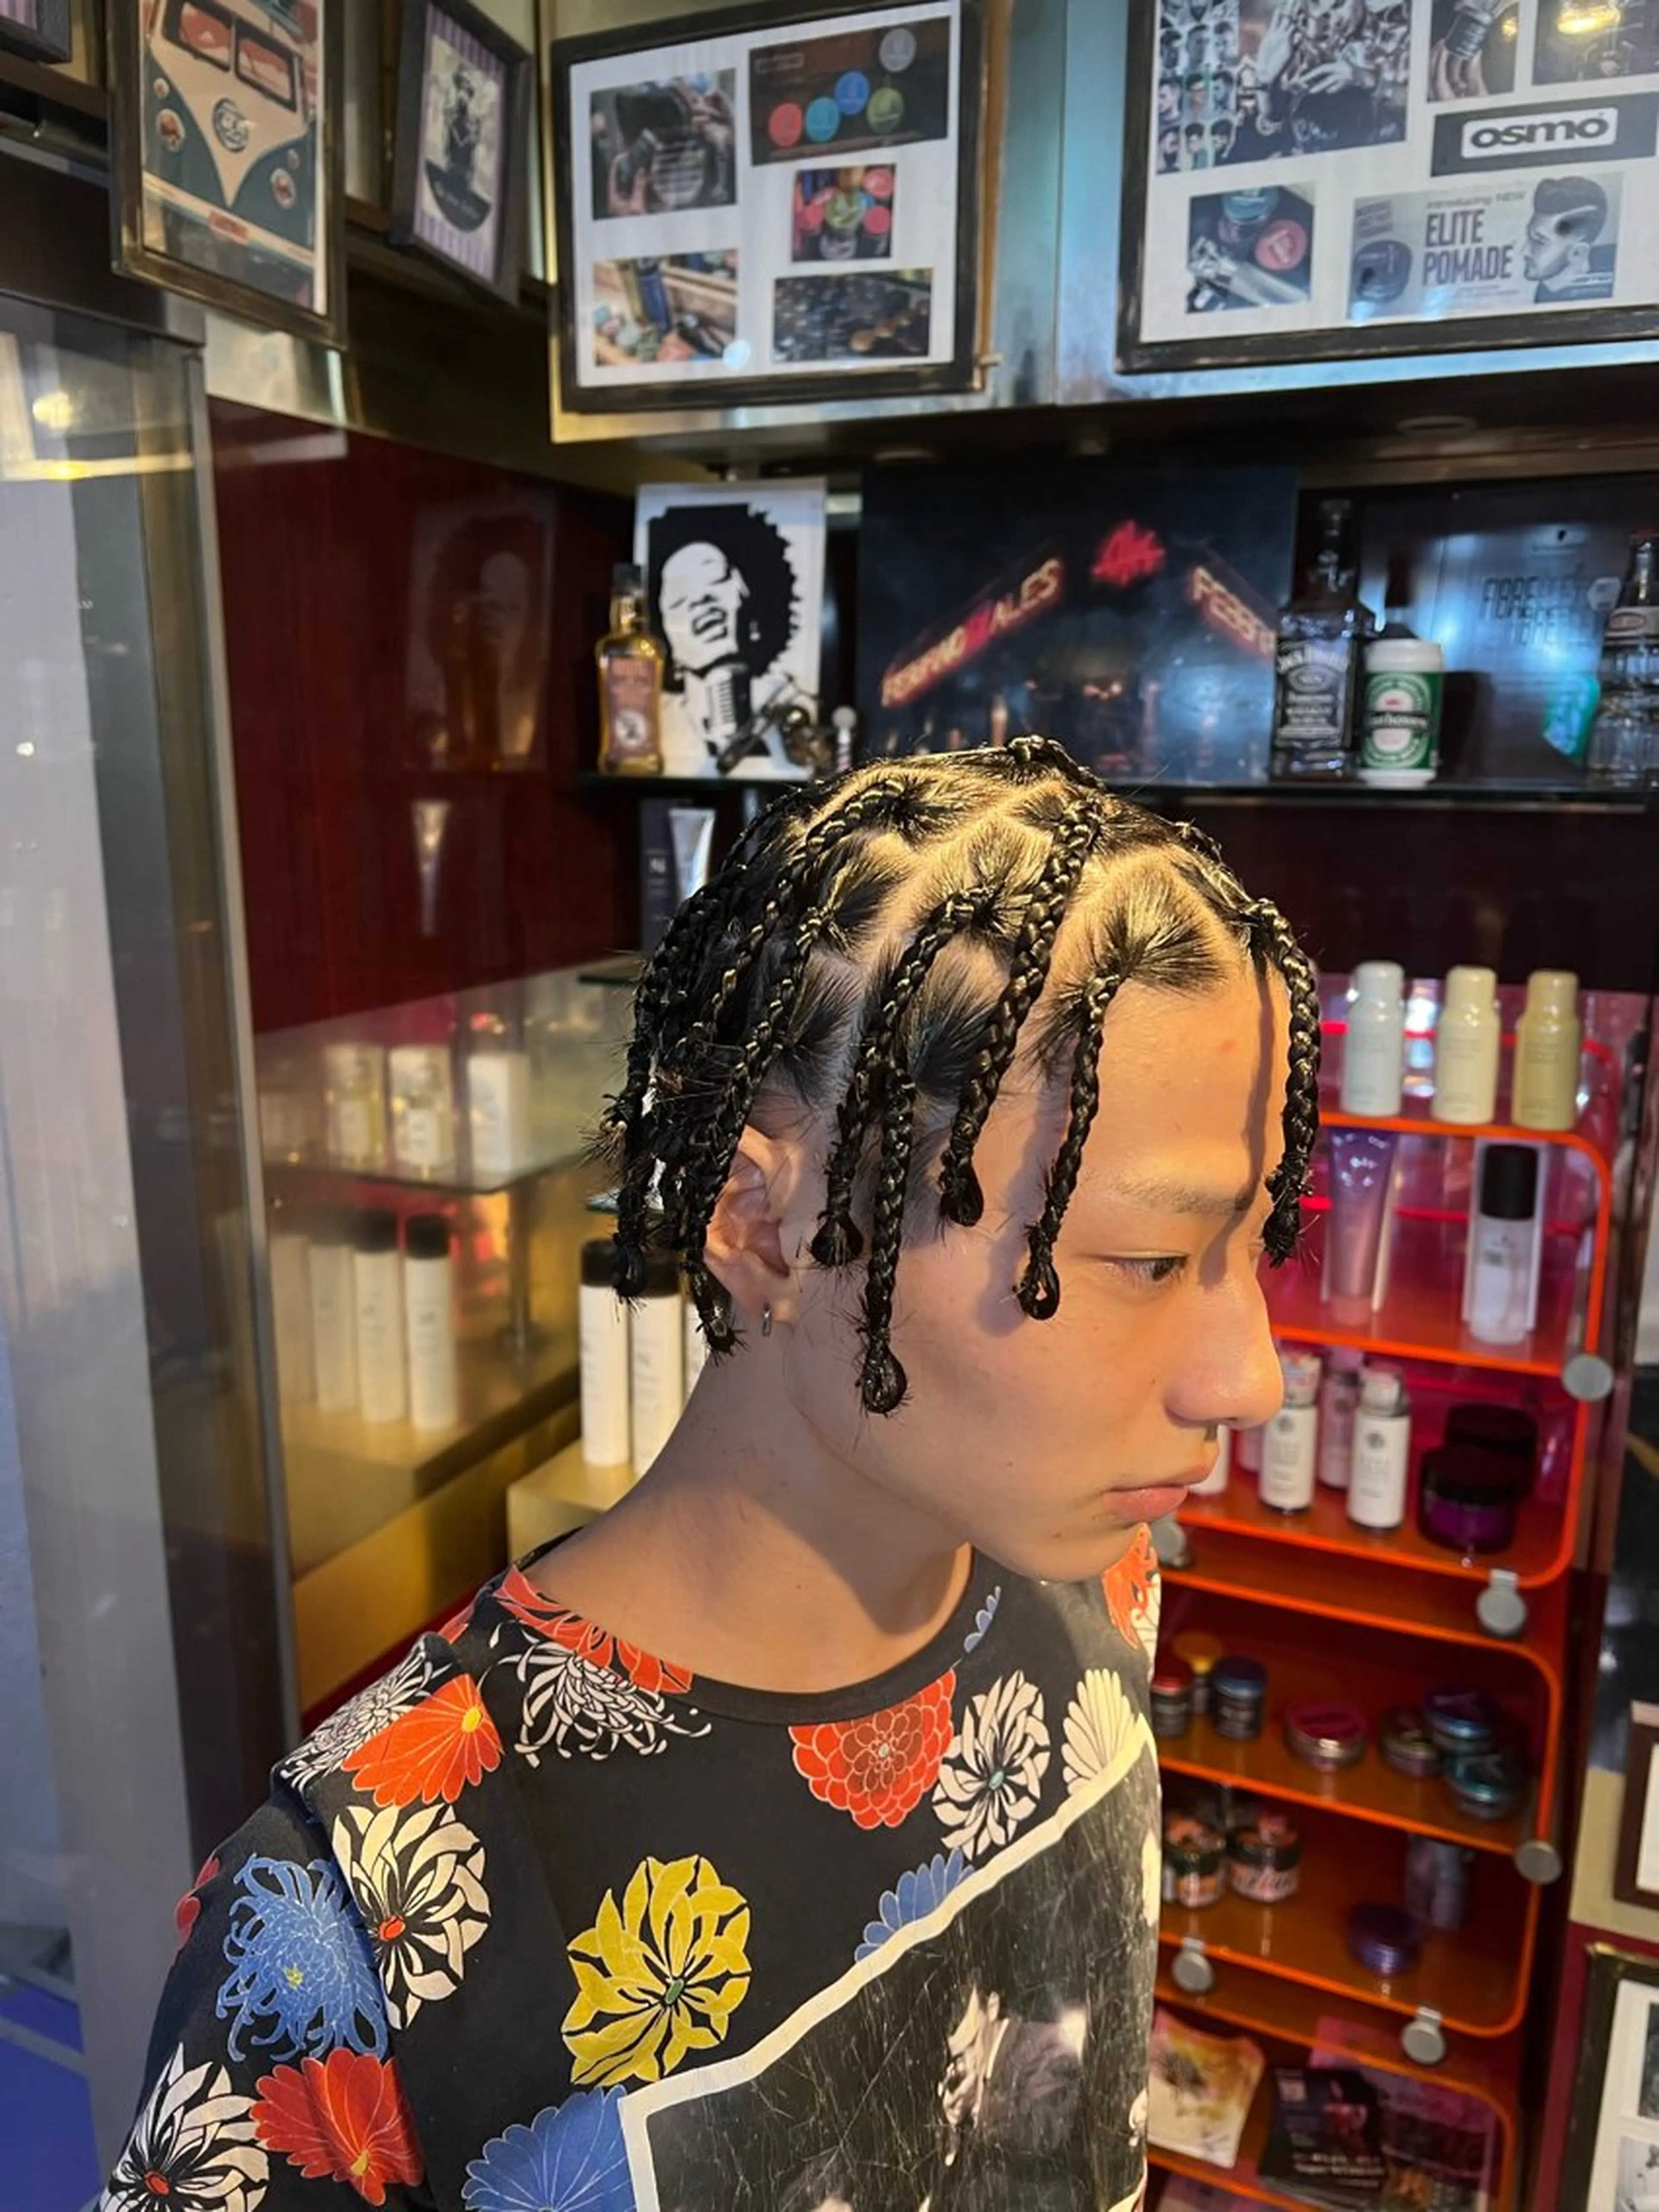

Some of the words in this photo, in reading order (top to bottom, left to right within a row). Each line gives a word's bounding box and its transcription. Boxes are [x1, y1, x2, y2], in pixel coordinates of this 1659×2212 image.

[1470, 118, 1610, 148] osmo
[1426, 208, 1485, 248] ELITE
[1422, 244, 1514, 286] POMADE
